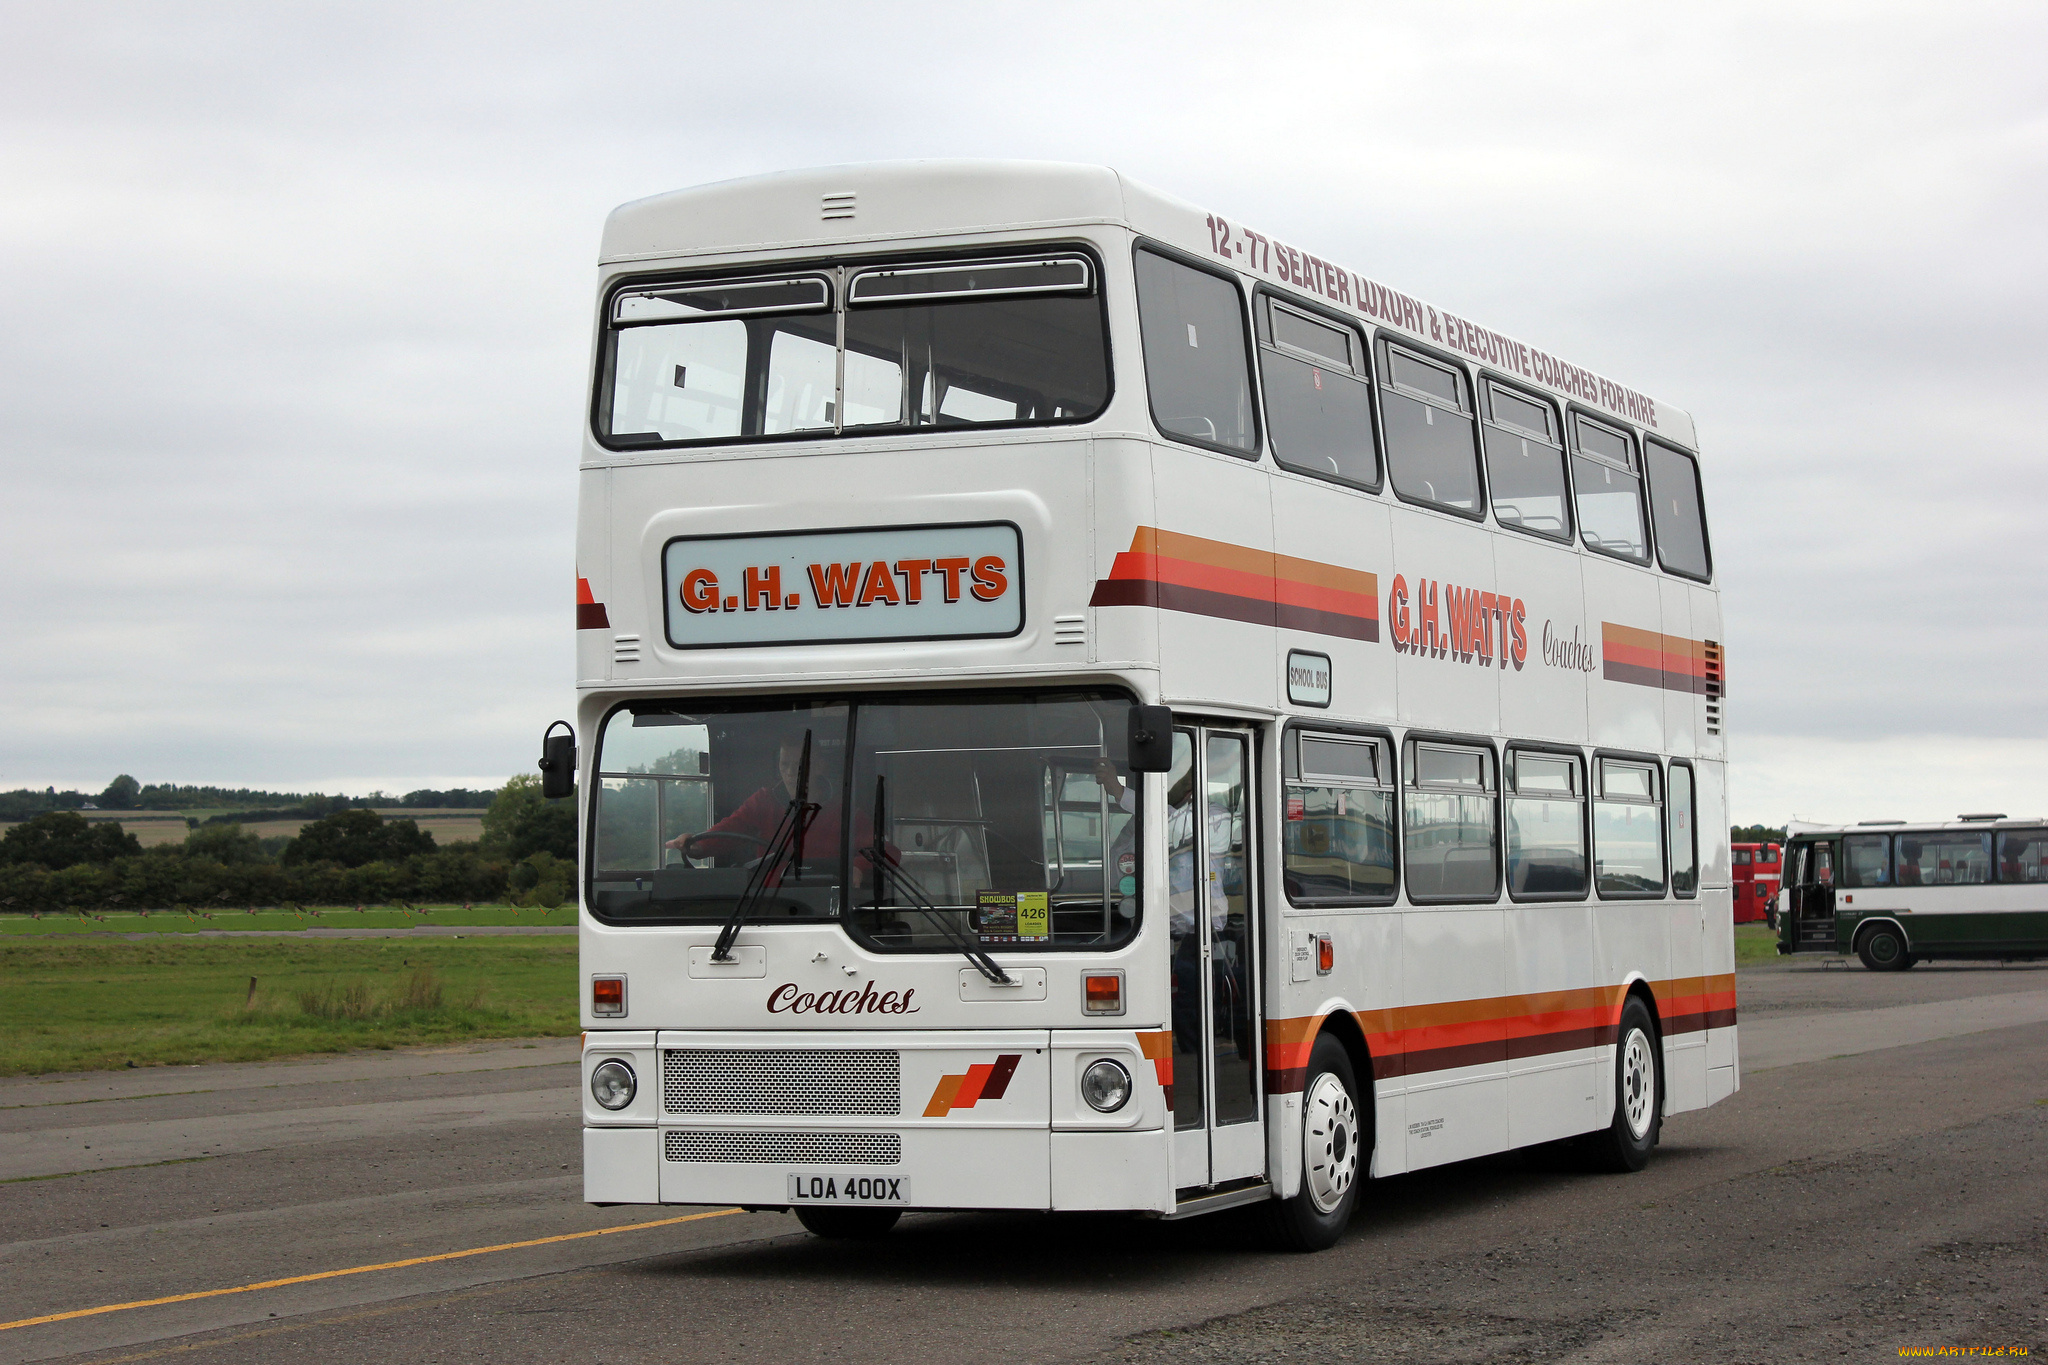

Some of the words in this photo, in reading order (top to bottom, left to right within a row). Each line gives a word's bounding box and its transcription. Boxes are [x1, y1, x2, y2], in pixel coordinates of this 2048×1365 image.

[1206, 212, 1232, 259] 12
[1242, 227, 1269, 273] 77
[1272, 240, 1351, 306] SEATER
[1352, 273, 1424, 335] LUXURY
[1427, 304, 1443, 342] &
[1441, 311, 1532, 377] EXECUTIVE
[1531, 348, 1598, 403] COACHES
[1598, 376, 1627, 415] FOR
[1625, 387, 1658, 428] HIRE
[1542, 619, 1597, 673] Coaches
[1290, 666, 1315, 688] SCHOOL
[1316, 670, 1328, 690] BUS
[1021, 908, 1046, 919] 426
[766, 980, 921, 1015] Coaches
[796, 1176, 838, 1199] LOA
[844, 1177, 901, 1200] 400X
